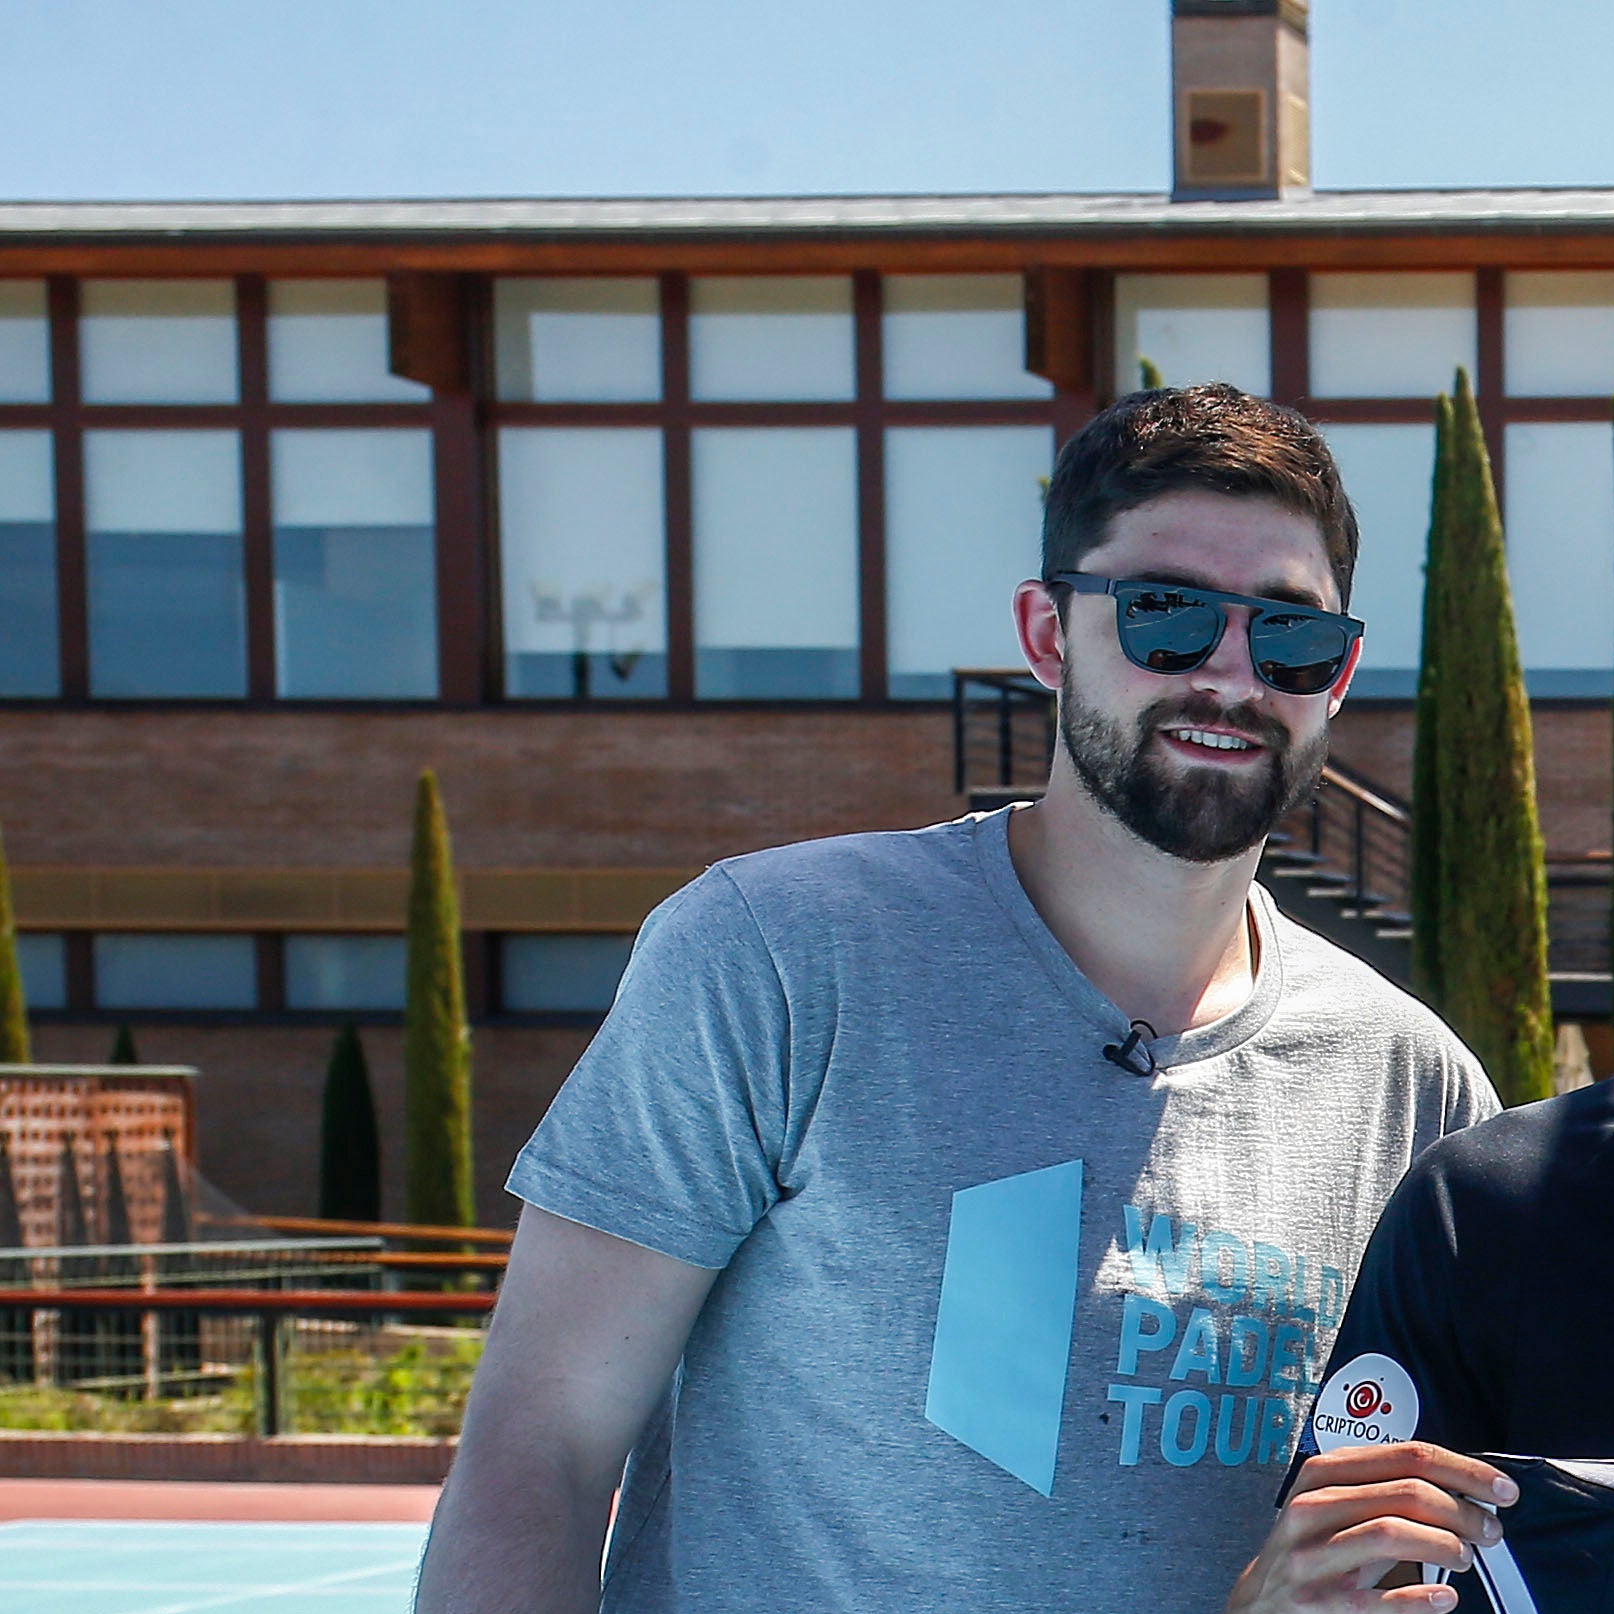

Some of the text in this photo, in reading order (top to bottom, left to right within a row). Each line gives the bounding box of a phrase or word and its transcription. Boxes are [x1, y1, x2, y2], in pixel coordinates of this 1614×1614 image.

[1123, 1204, 1345, 1328] WORLD
[1117, 1293, 1321, 1394] PADEL
[1108, 1383, 1294, 1467] TOUR
[1315, 1414, 1380, 1441] CRIPTOO
